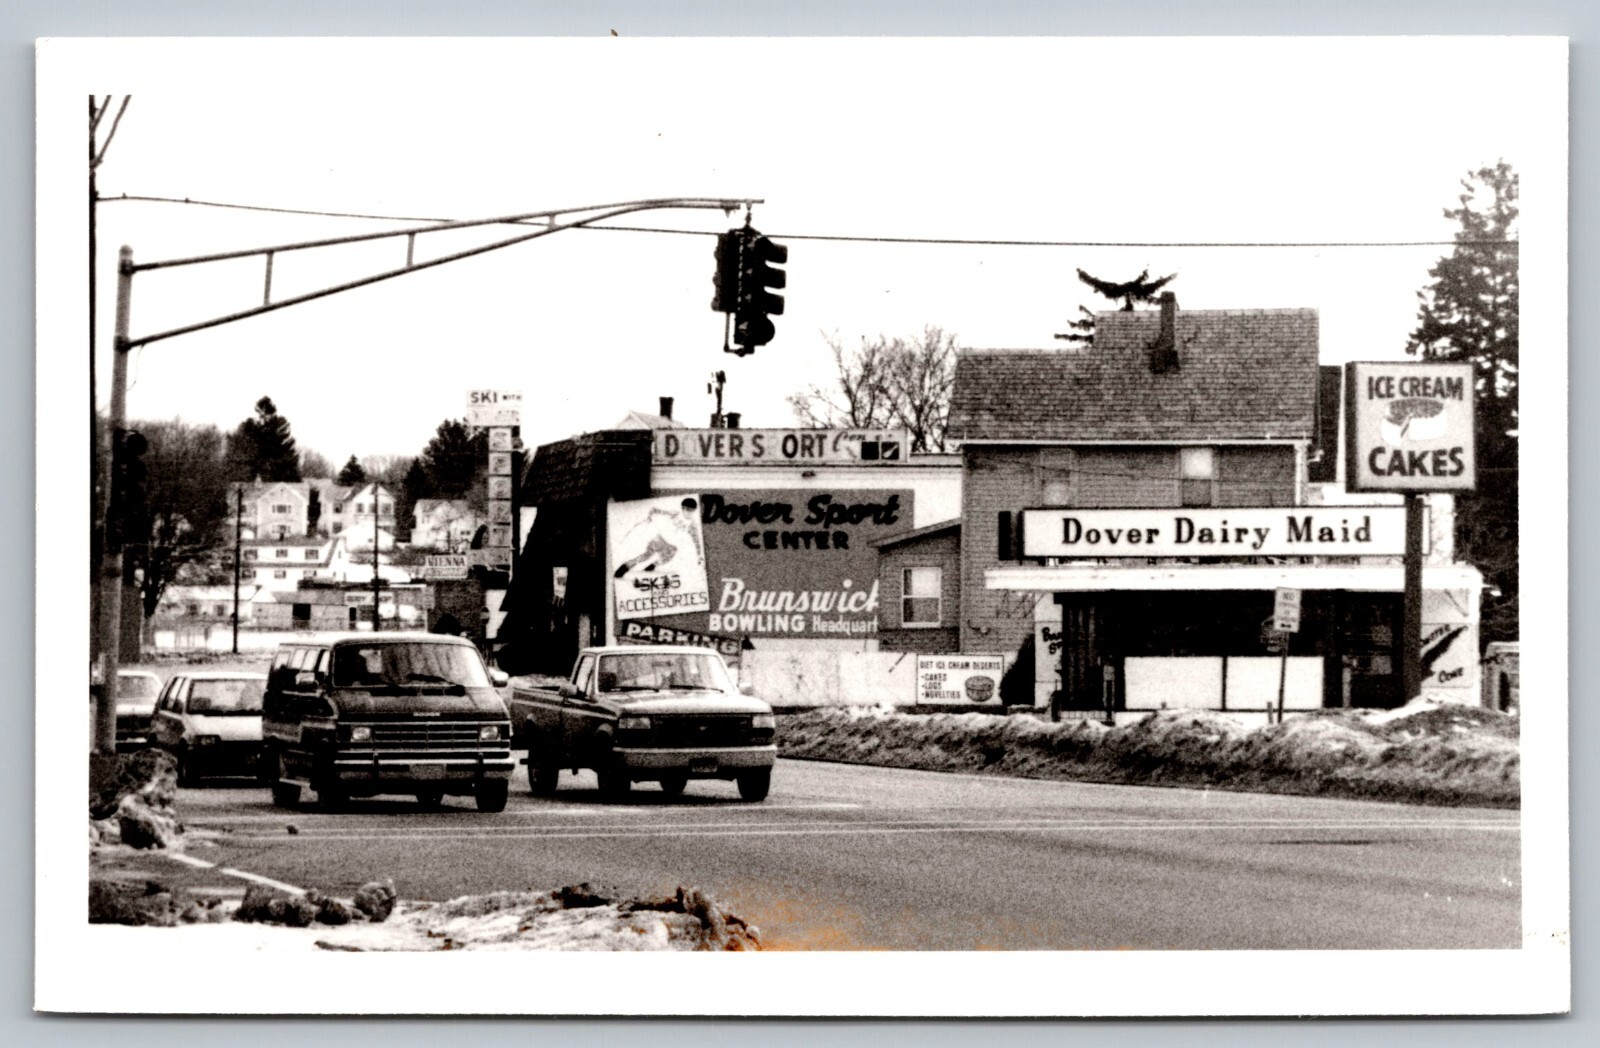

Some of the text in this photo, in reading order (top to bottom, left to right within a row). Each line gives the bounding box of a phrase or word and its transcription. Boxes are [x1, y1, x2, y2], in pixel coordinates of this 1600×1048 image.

[470, 391, 498, 403] SKI
[1367, 376, 1463, 400] ICE CREAM
[1368, 446, 1464, 476] CAKES
[701, 493, 900, 529] Dover Sport
[743, 530, 850, 550] CENTER
[1061, 515, 1372, 550] Dover Dairy Maid
[428, 556, 465, 567] VIENNA
[640, 574, 681, 592] SKIS
[619, 591, 708, 612] ACCESSORIES
[709, 613, 805, 632] BOWLING
